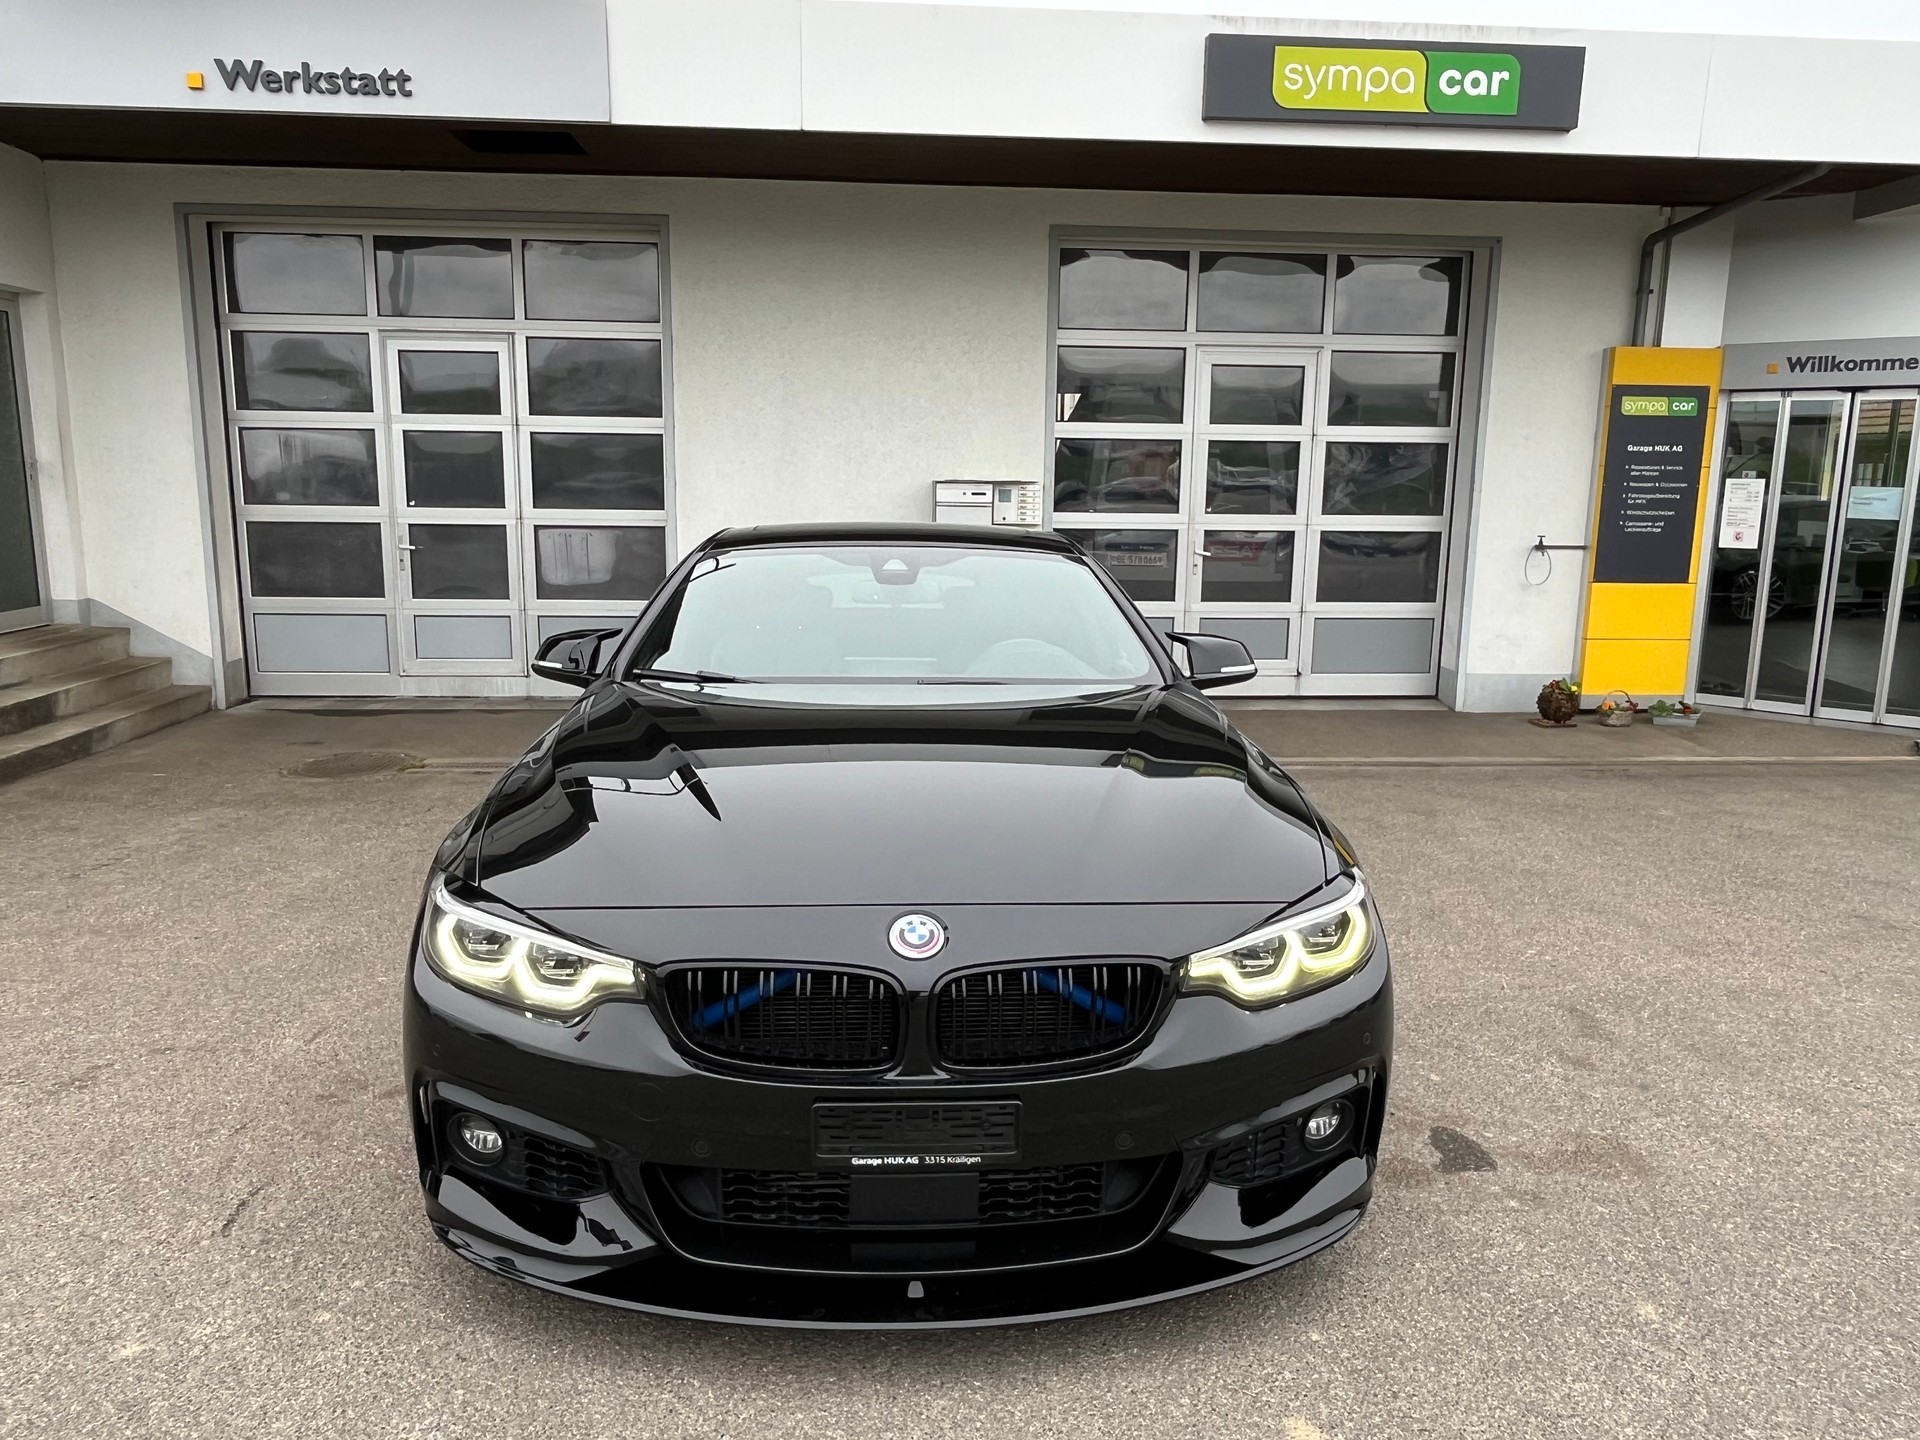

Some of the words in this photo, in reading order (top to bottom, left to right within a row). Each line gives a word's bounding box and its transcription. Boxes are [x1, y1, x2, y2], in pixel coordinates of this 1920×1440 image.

[213, 58, 413, 97] Werkstatt
[1283, 63, 1416, 102] sympa
[1438, 69, 1510, 96] car
[1786, 355, 1920, 374] Willkomme
[1624, 401, 1666, 413] sympa
[1672, 401, 1695, 411] car
[1627, 444, 1653, 453] Garage
[851, 1157, 883, 1167] Garage
[883, 1156, 904, 1165] HUK
[905, 1156, 919, 1165] AG
[924, 1155, 946, 1164] 3315
